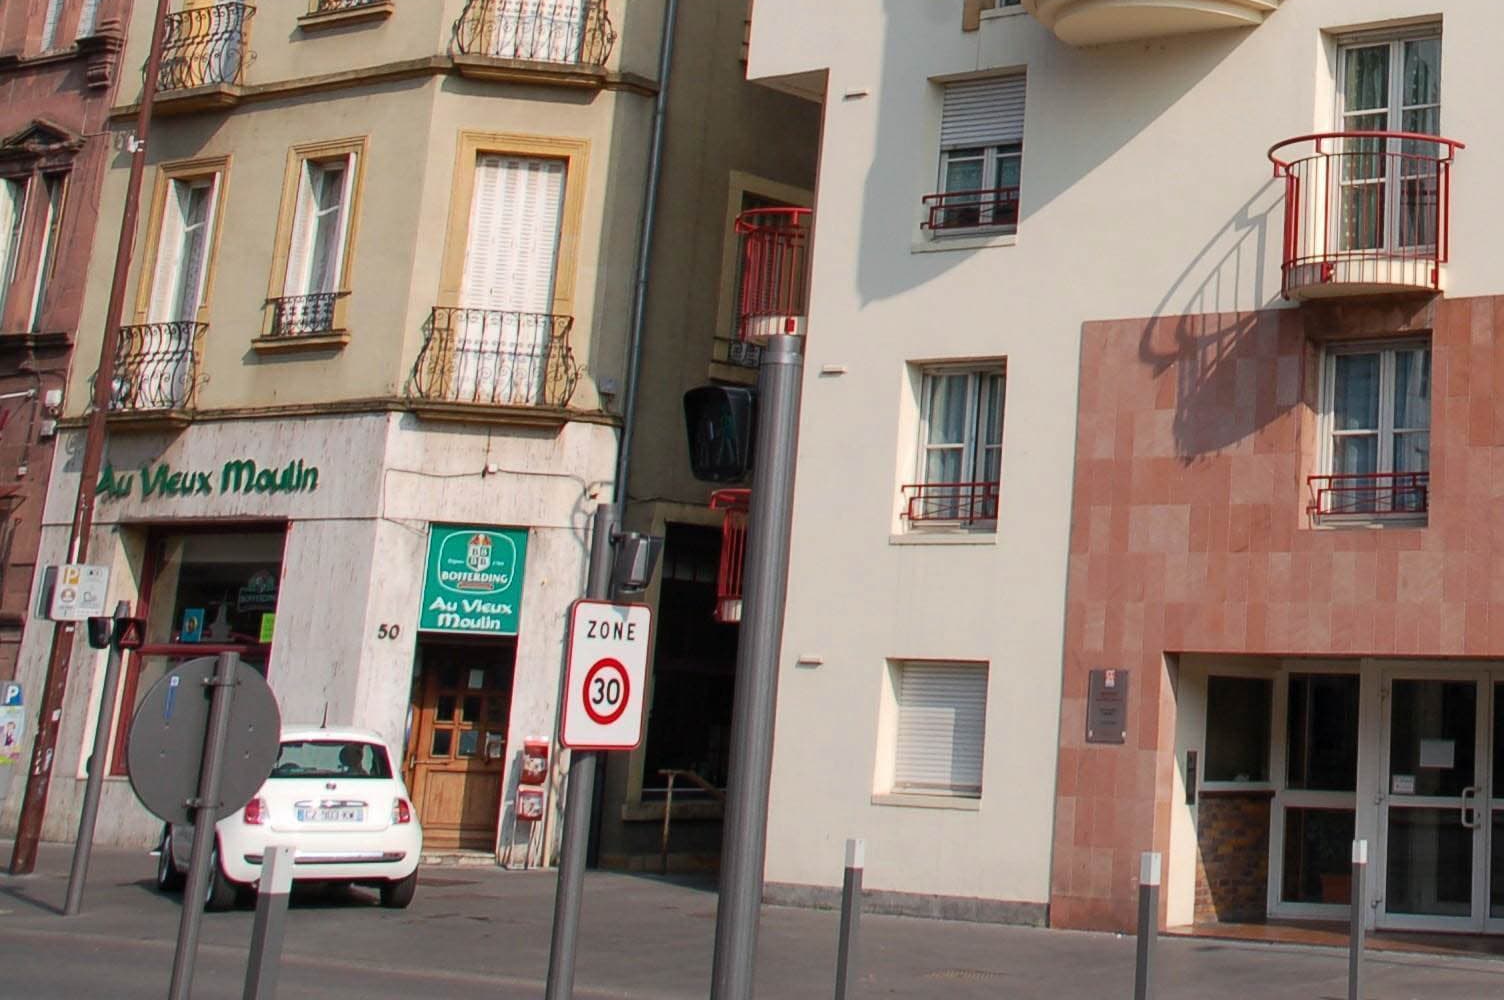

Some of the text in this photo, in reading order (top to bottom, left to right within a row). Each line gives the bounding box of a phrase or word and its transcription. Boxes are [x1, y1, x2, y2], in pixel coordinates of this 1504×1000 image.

[96, 457, 318, 500] Au Vieux Moulin
[430, 597, 512, 615] Au Vieux
[437, 613, 501, 630] Moulin
[587, 620, 636, 641] ZONE
[377, 623, 400, 641] 50
[5, 685, 20, 704] P
[591, 677, 620, 705] 30
